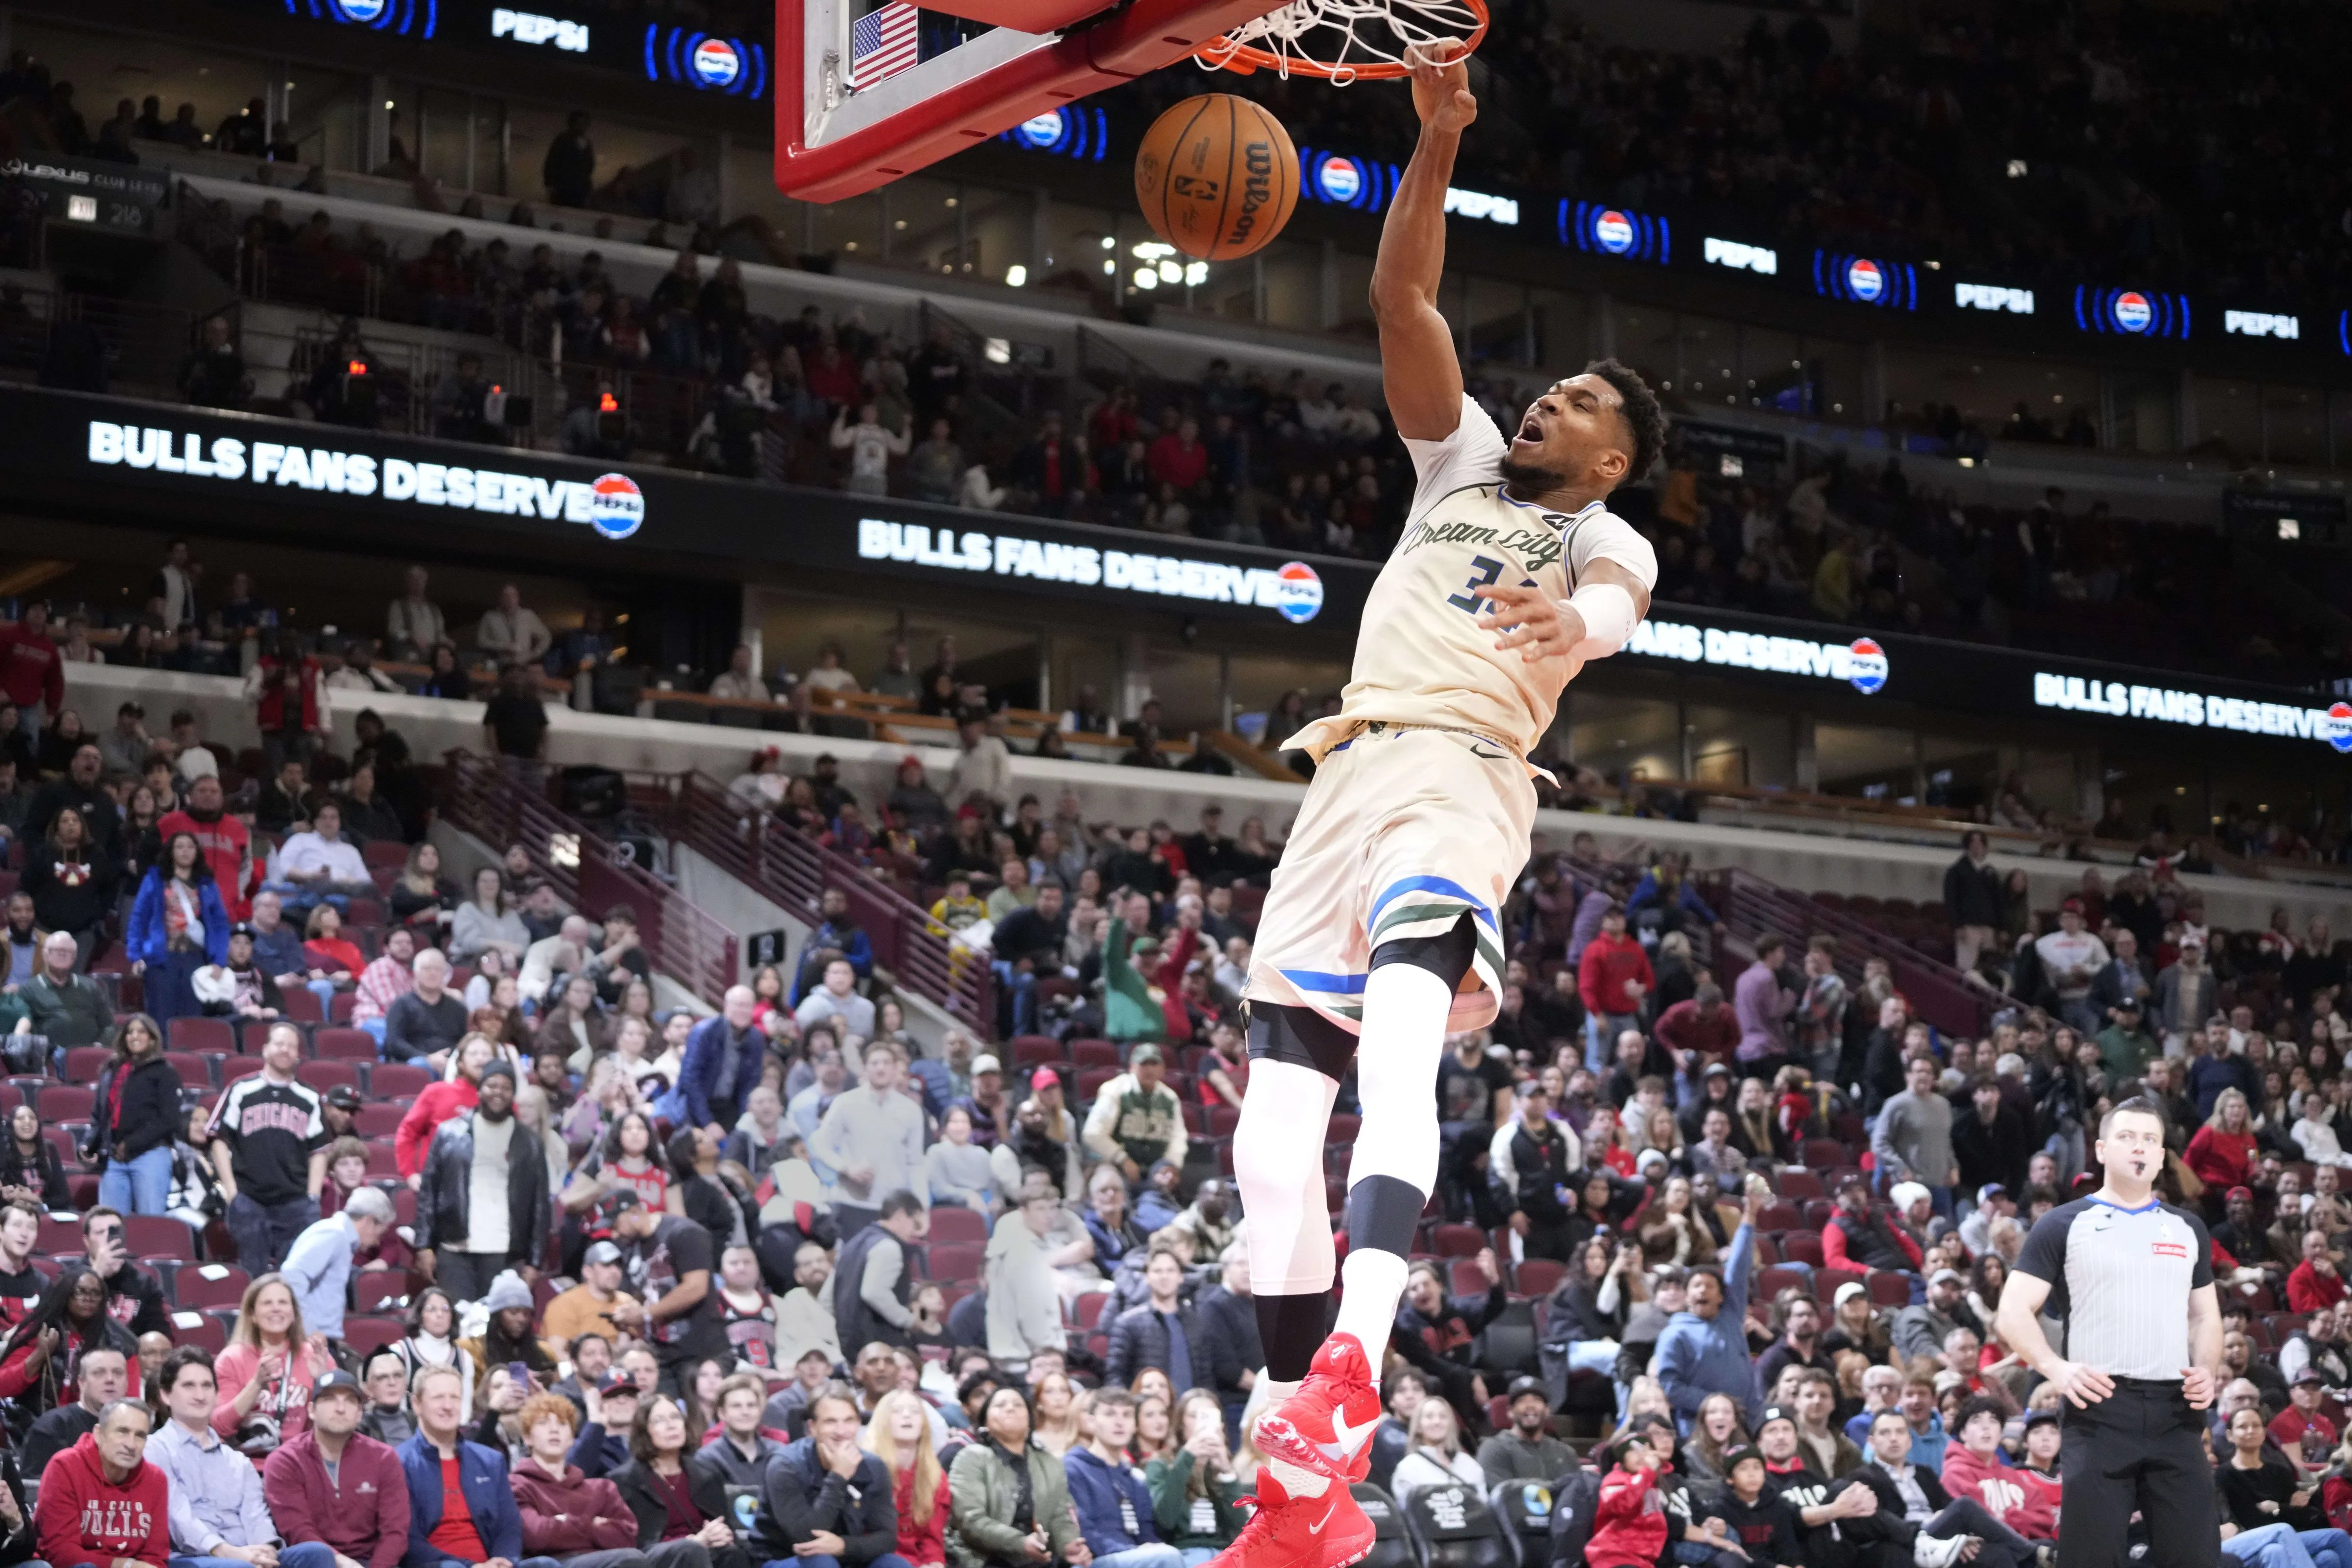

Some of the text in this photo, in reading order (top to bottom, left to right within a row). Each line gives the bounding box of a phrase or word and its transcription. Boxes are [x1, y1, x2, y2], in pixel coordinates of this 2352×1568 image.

[492, 8, 588, 52] PEPSI
[1227, 141, 1272, 245] Wilson
[1704, 238, 1777, 275] PEPSI
[1955, 283, 2034, 314] PEPSI
[2225, 310, 2299, 339] PEPSI
[88, 421, 592, 525] BULLS FANS DESERVE
[858, 519, 1279, 608] BULLS FANS DESERVE
[1403, 521, 1565, 572] Cream City
[1620, 619, 1851, 681] ANS DESERVE
[2034, 672, 2328, 741] BULLS FANS DESERVE
[747, 1338, 771, 1368] 9
